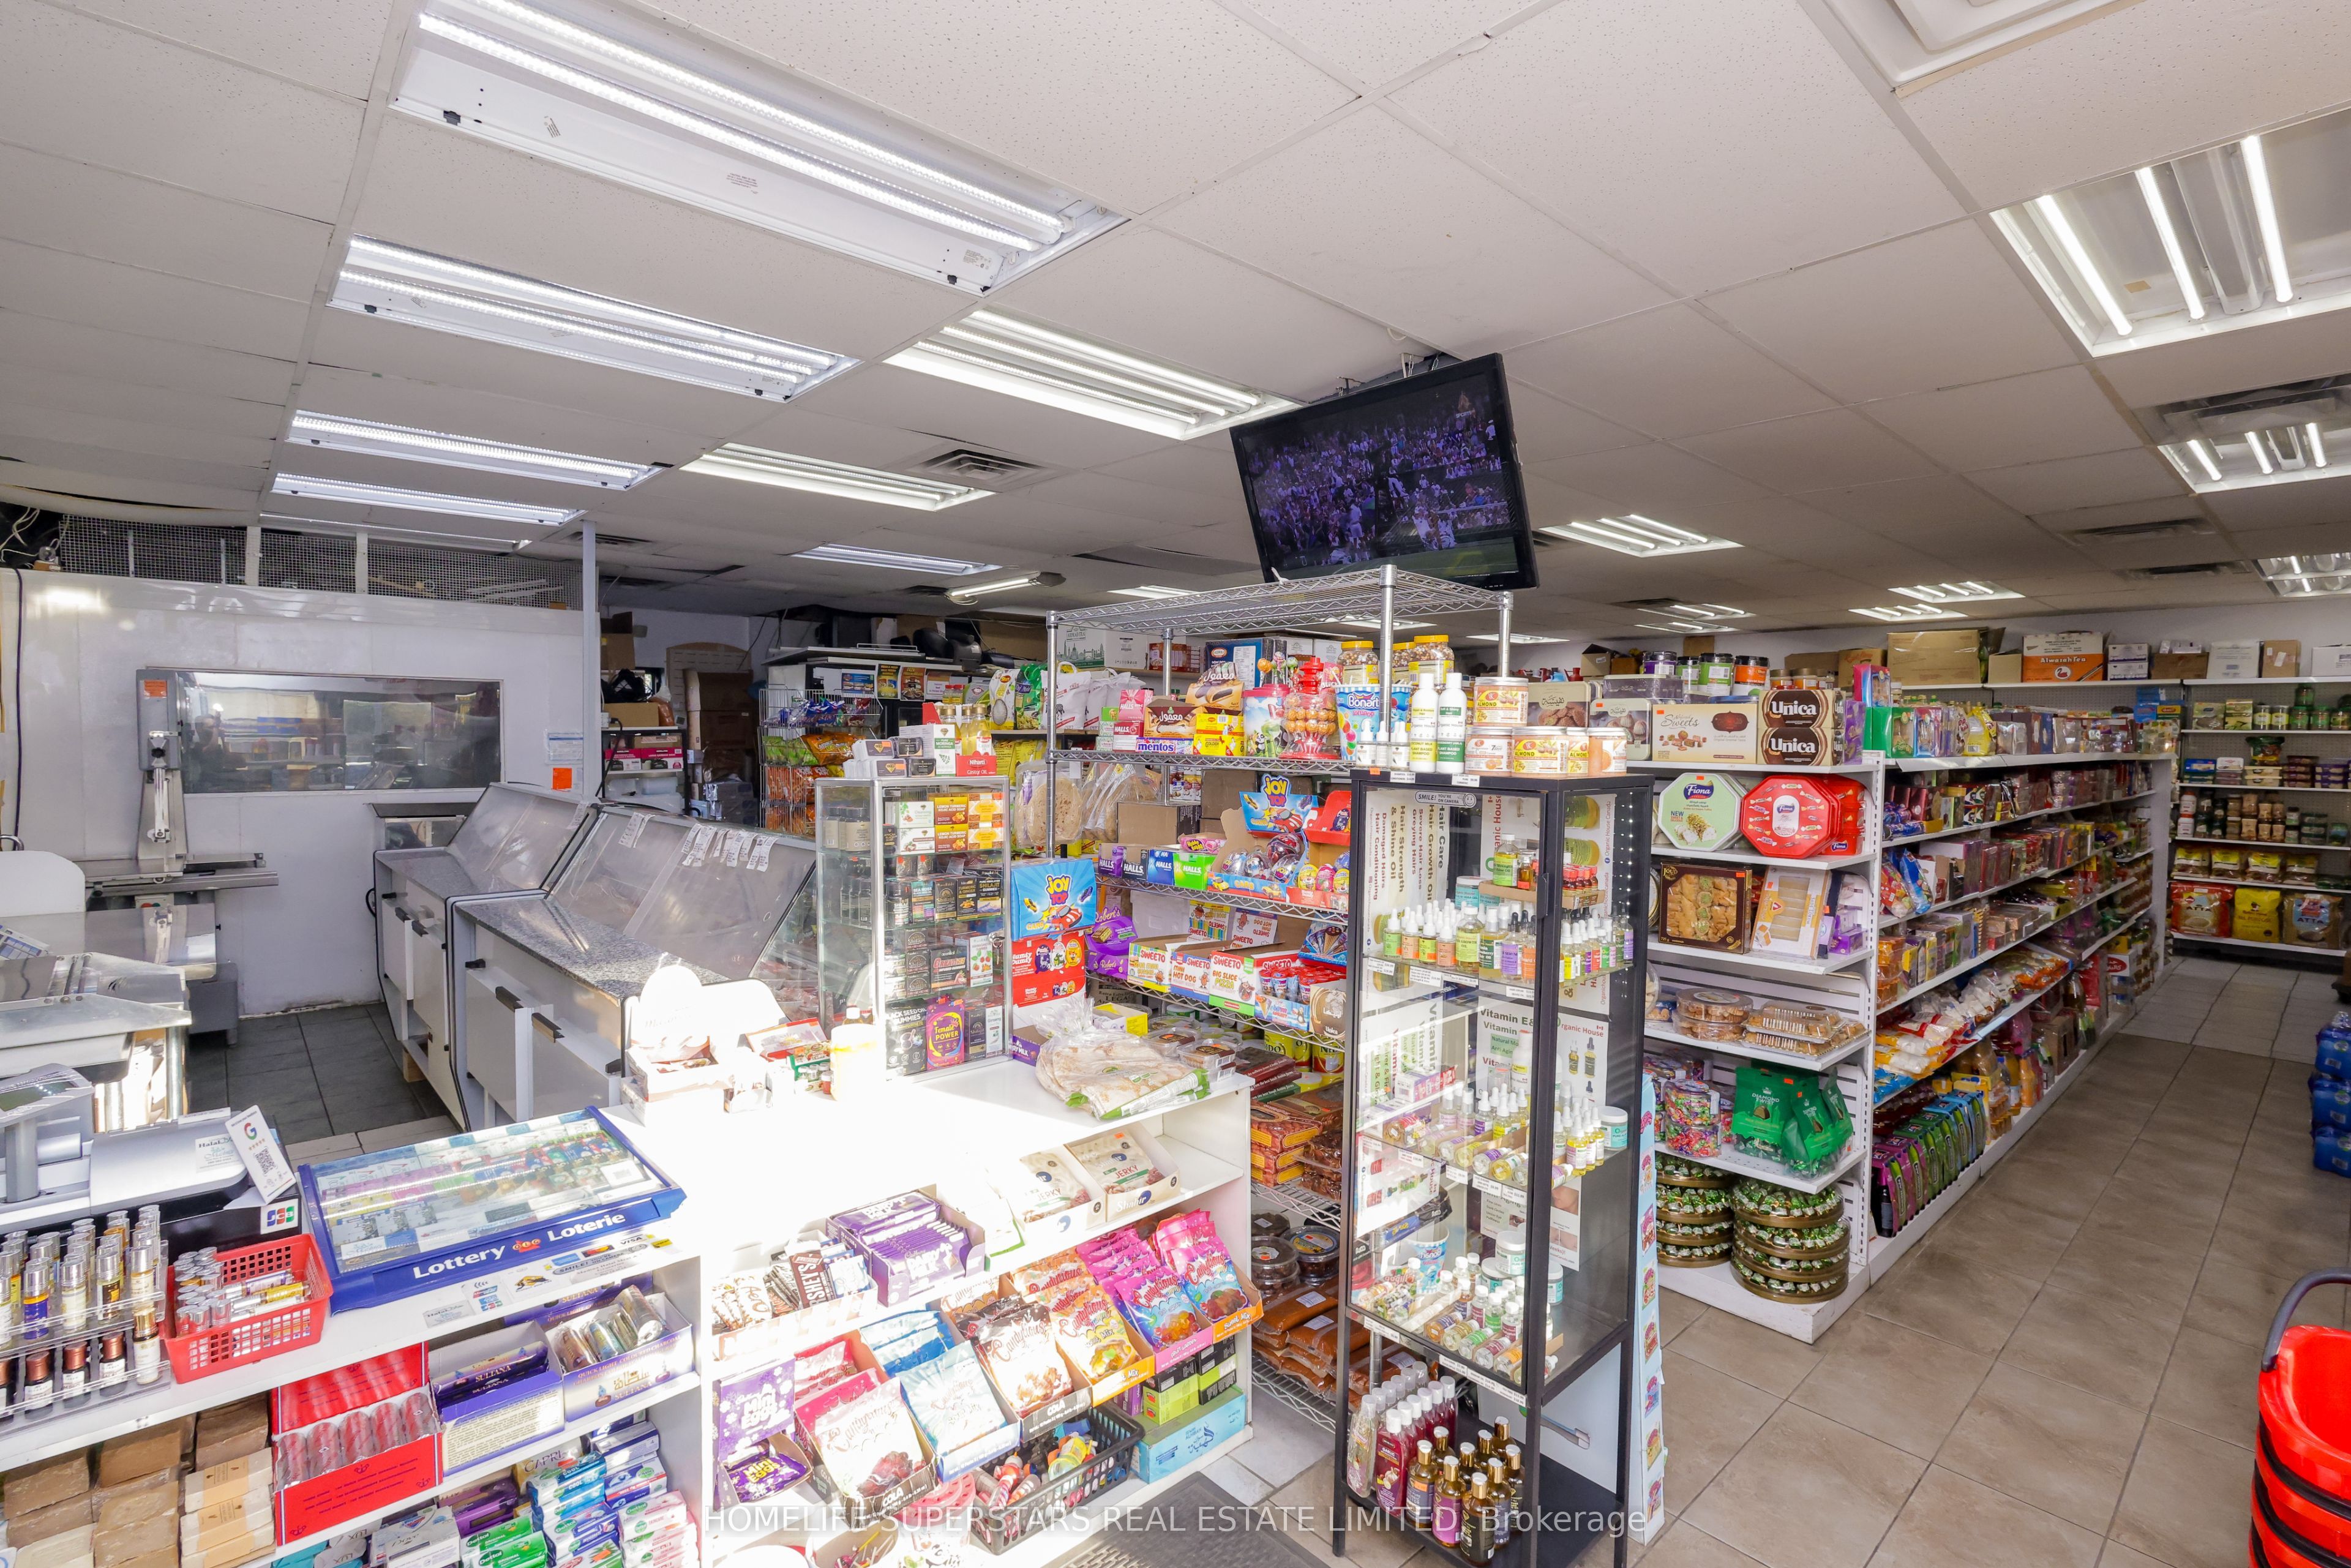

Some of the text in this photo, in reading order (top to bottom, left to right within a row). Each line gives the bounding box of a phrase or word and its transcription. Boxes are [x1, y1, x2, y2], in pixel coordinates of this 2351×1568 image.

[1772, 700, 1817, 716] Unica
[1661, 715, 1699, 727] Sweets
[1138, 741, 1174, 752] mentos
[1771, 738, 1816, 754] Unica
[1687, 785, 1711, 796] Fiona
[1391, 806, 1397, 816] &
[1099, 860, 1115, 868] HALLS
[1124, 864, 1144, 874] HALLS
[1156, 861, 1172, 869] HALLS
[1183, 865, 1202, 874] HALLS
[1190, 928, 1207, 937] SWEETO
[1234, 935, 1253, 943] SWEETO
[1141, 949, 1166, 962] SWEETO
[1187, 957, 1210, 970] SWEETO
[1213, 956, 1241, 970] SWEETO
[1222, 972, 1238, 981] SLICE
[1215, 978, 1234, 989] PIZZA
[1480, 1008, 1518, 1024] Vitamin
[935, 1025, 954, 1033] Female
[1483, 1021, 1517, 1035] Vitamin
[1583, 1027, 1604, 1038] House
[936, 1031, 959, 1041] POWER
[1492, 1036, 1510, 1045] Natural
[1752, 1093, 1780, 1103] DIAMOND
[1115, 1165, 1139, 1179] JERKY
[1037, 1187, 1062, 1201] JERKY
[267, 1206, 294, 1227] JCB
[413, 1212, 626, 1279] Lottery Loterie
[620, 1236, 643, 1245] VISA
[558, 1262, 588, 1274] SMILE!
[475, 1365, 512, 1383] SULTANA
[577, 1367, 599, 1379] QUICK
[599, 1360, 618, 1373] LIGHT
[614, 1382, 653, 1401] SULTANA
[743, 1459, 773, 1477] Mini
[746, 1462, 781, 1484] Eggs
[568, 1480, 582, 1490] COOL
[882, 1487, 904, 1506] COLA
[626, 1502, 648, 1515] Dettol
[555, 1520, 577, 1534] Dettol
[467, 1532, 490, 1547] Dettol
[484, 1534, 506, 1544] ORIGINAL
[479, 1550, 503, 1566] Dettol
[498, 1553, 520, 1564] ORIGINAL
